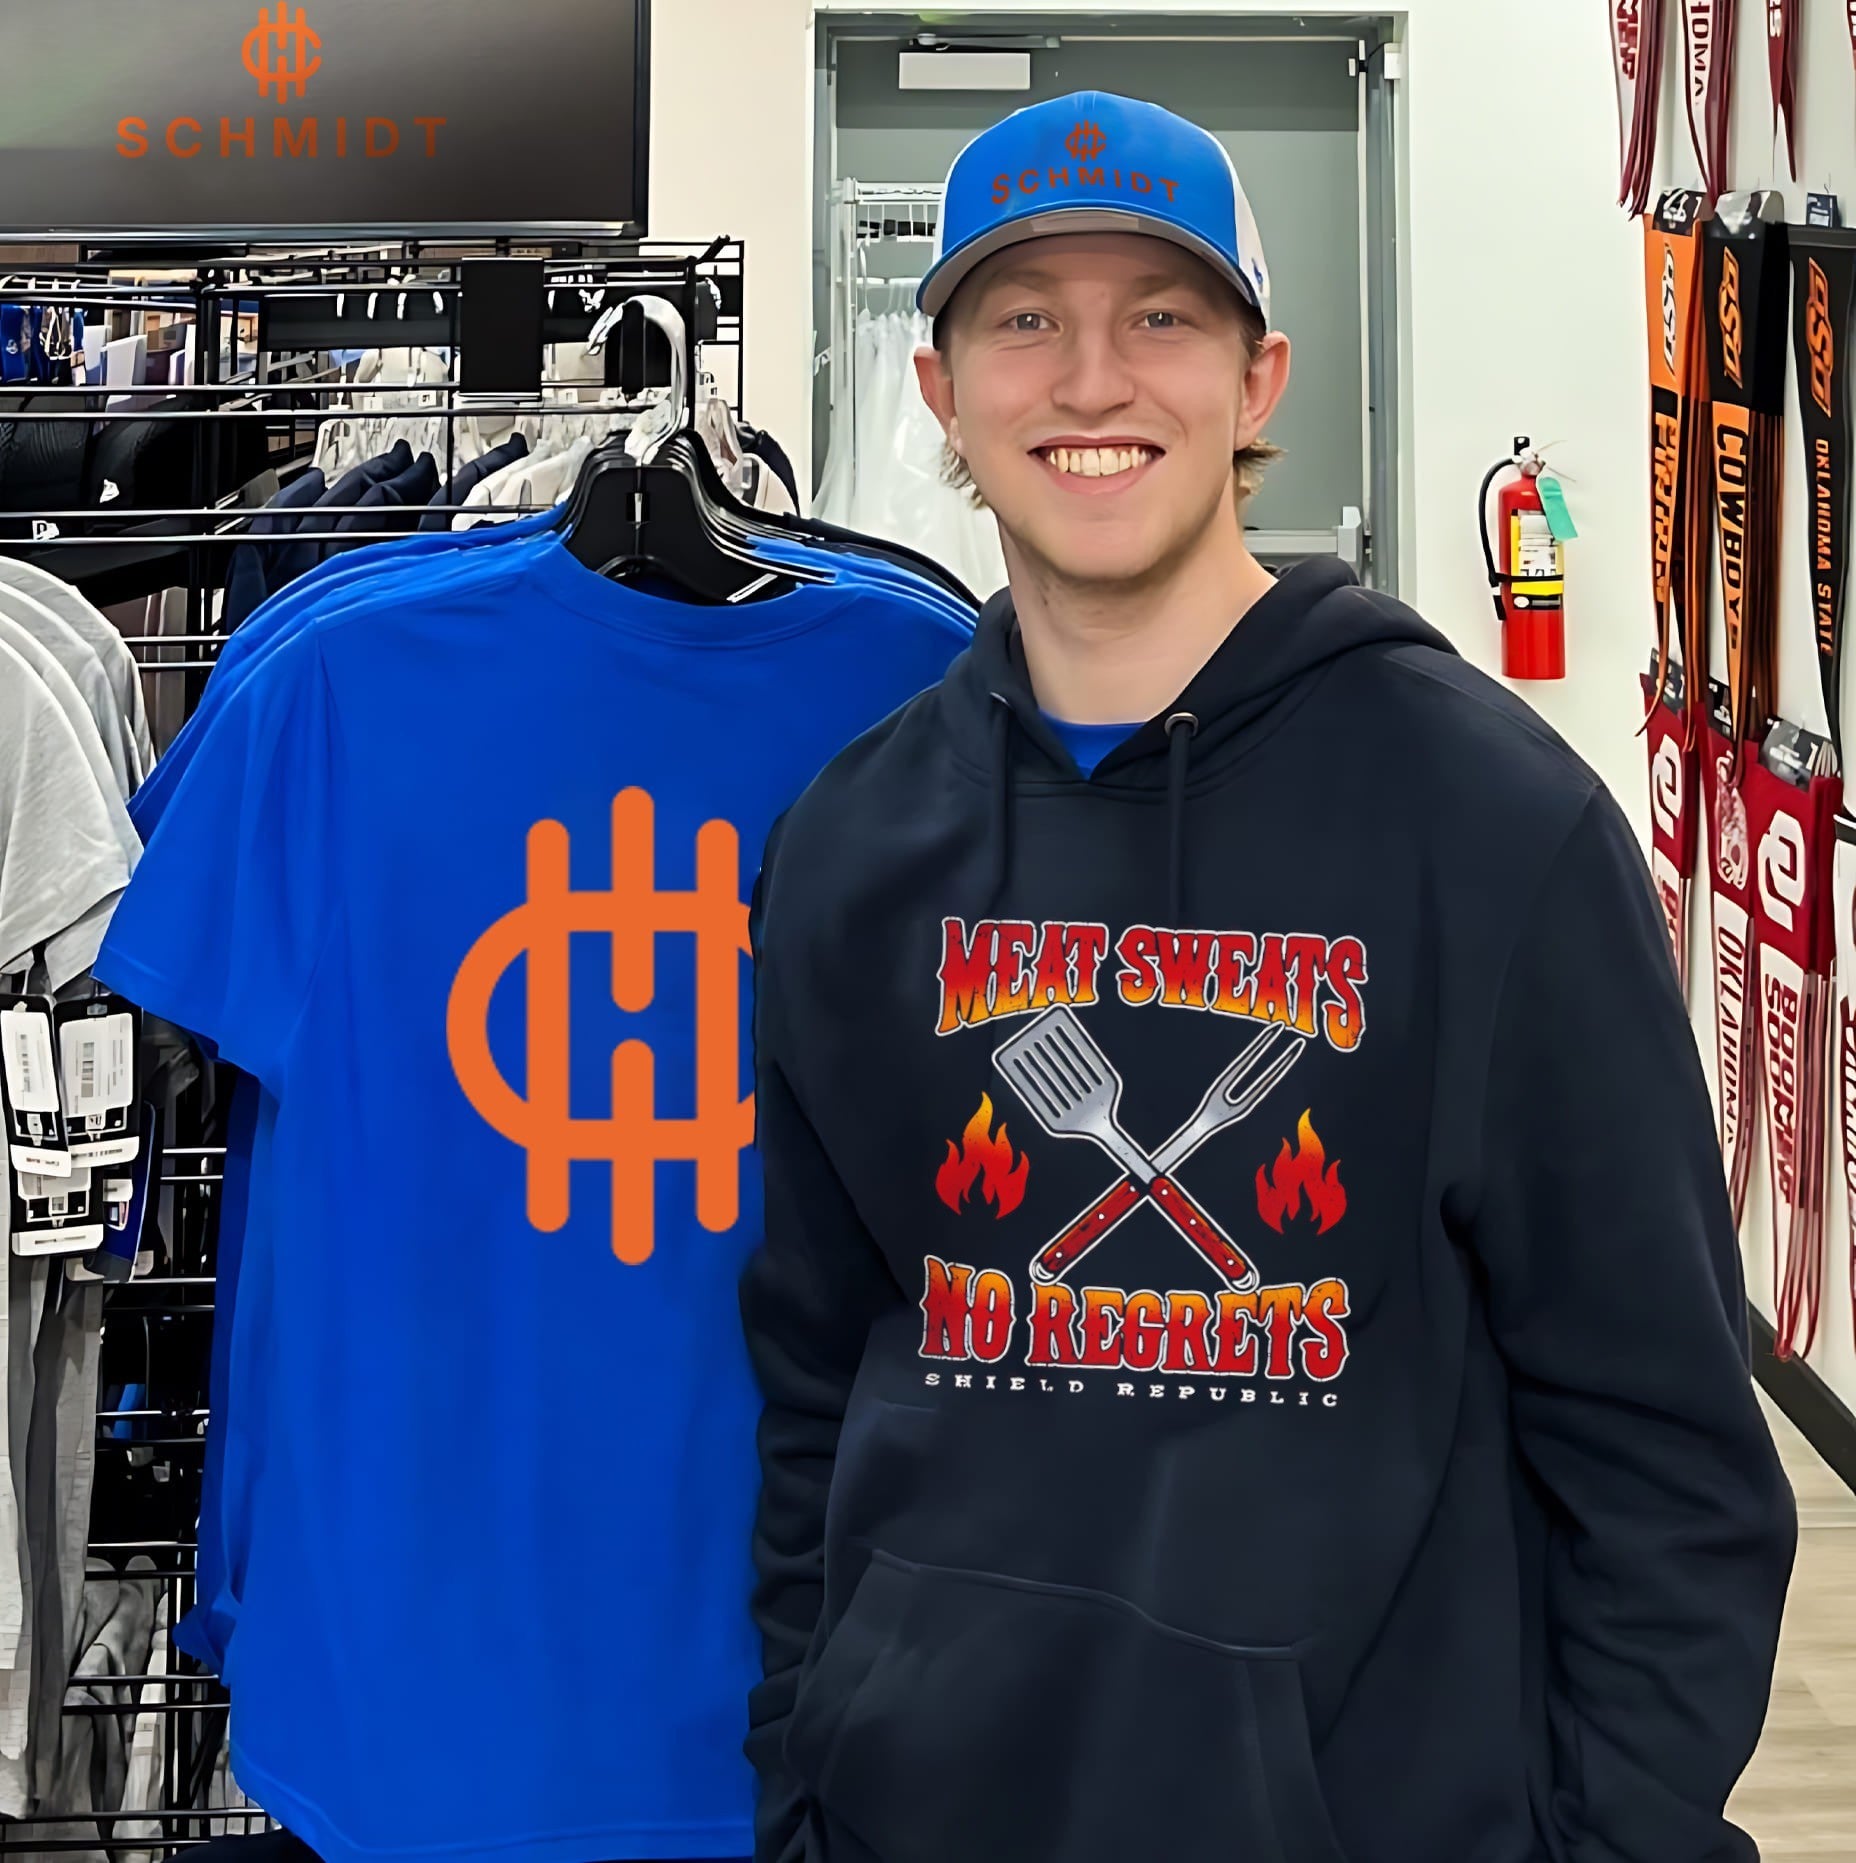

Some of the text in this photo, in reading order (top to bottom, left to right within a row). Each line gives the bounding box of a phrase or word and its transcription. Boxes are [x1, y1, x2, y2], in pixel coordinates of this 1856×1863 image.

[116, 117, 447, 158] SCHMIDT
[992, 167, 1179, 204] SCHMIDT
[1815, 438, 1834, 656] OKLAHOMA STATE
[936, 917, 1368, 1052] MEAT SWEATS
[1718, 926, 1745, 1144] OKLAHOMA
[919, 1255, 1351, 1382] NO REGRETS
[925, 1373, 1338, 1406] SHIELD REPUBLIC
